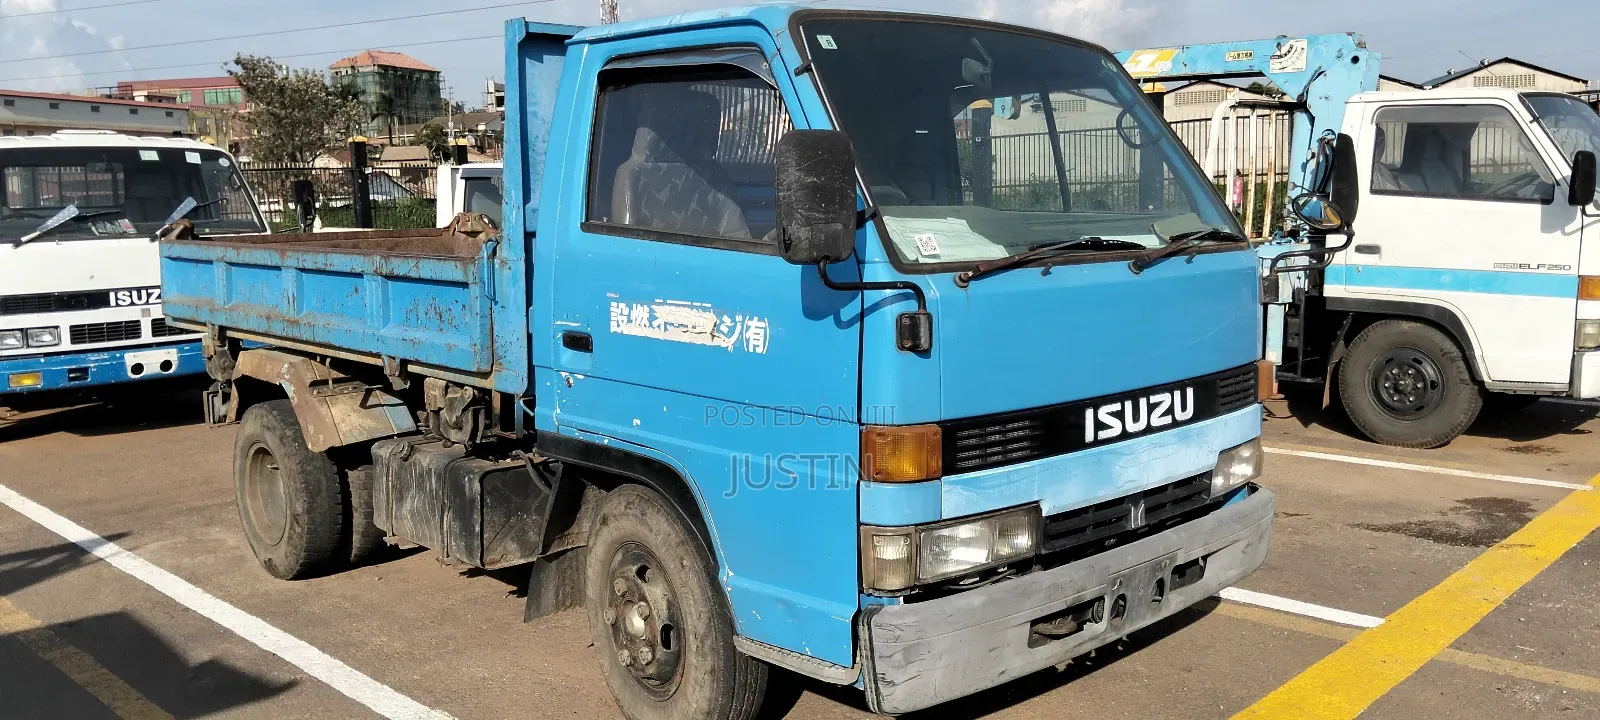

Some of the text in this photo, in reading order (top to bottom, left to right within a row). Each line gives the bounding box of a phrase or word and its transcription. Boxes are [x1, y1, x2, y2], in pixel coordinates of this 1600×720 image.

[1547, 263, 1572, 271] 250
[109, 288, 161, 307] ISUZ
[1084, 386, 1194, 443] ISUZU
